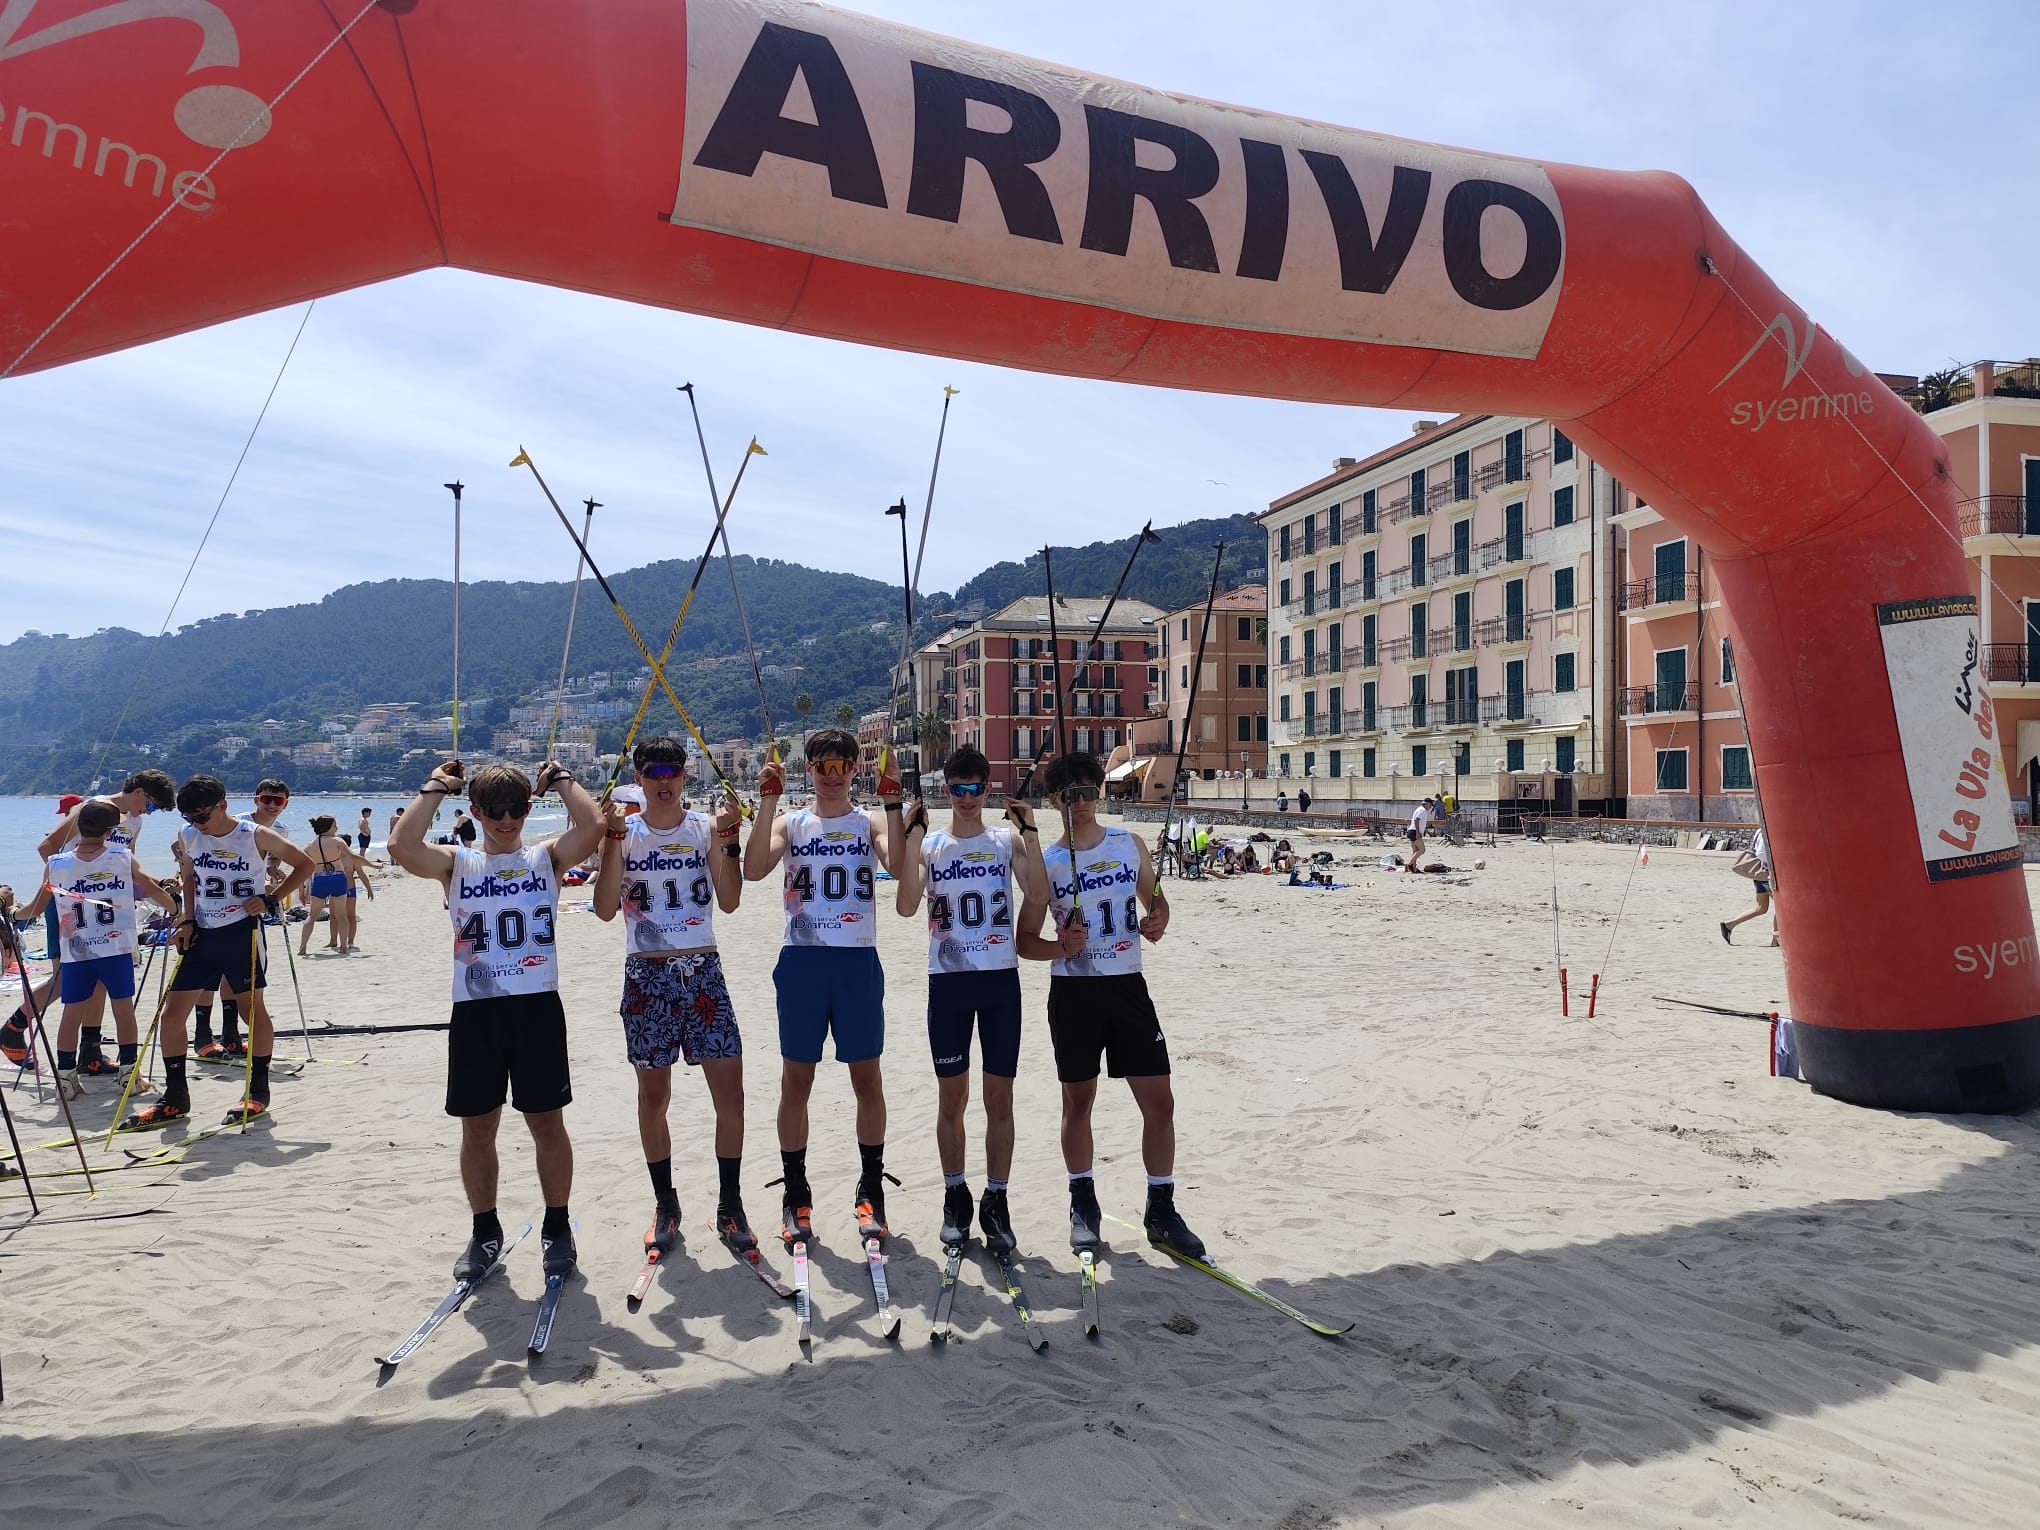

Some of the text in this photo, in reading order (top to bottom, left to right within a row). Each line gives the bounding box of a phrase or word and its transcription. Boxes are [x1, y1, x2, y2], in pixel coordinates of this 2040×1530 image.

[693, 21, 1561, 311] ARRIVO
[1729, 390, 1875, 432] syemme
[1955, 747, 1991, 800] Via
[1938, 809, 1981, 852] La
[626, 849, 706, 871] bottero ski
[791, 837, 870, 857] bottero ski
[229, 856, 250, 871] ski
[931, 860, 987, 882] bottero
[1115, 863, 1137, 883] ski
[107, 876, 125, 890] ski
[460, 871, 547, 899] bottero ski
[627, 874, 713, 913] 410
[792, 864, 875, 902] 409
[931, 889, 1012, 932] 402
[458, 904, 555, 954] 403
[470, 966, 524, 980] bianca
[935, 1054, 963, 1064] LEGEA
